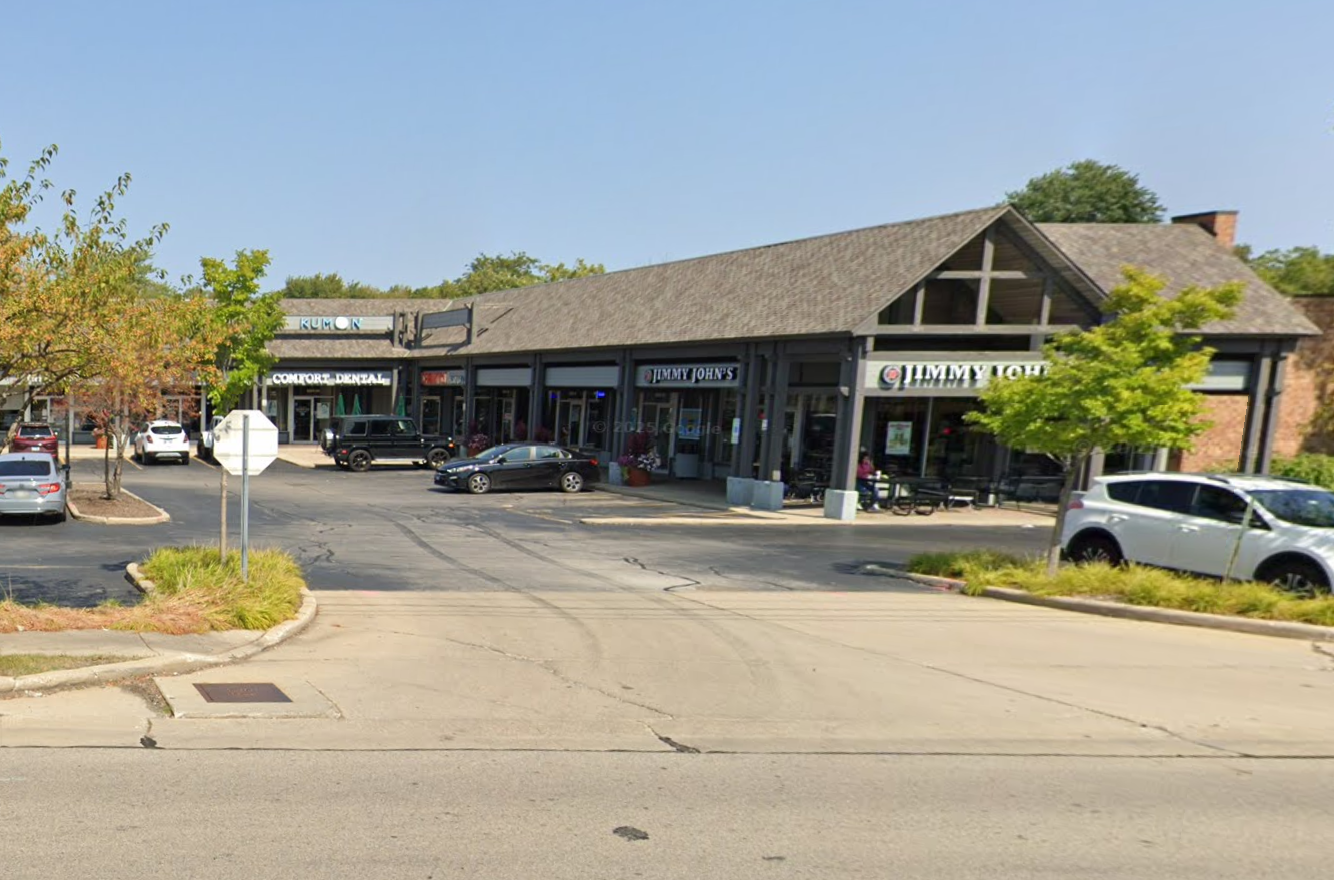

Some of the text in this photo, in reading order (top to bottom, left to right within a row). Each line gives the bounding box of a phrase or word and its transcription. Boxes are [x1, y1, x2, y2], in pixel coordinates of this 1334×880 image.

[299, 316, 362, 331] KUMON
[272, 372, 385, 386] COMFORT DENTAL
[652, 366, 733, 383] JIMMY JOHN'S
[904, 364, 987, 383] JIMMY
